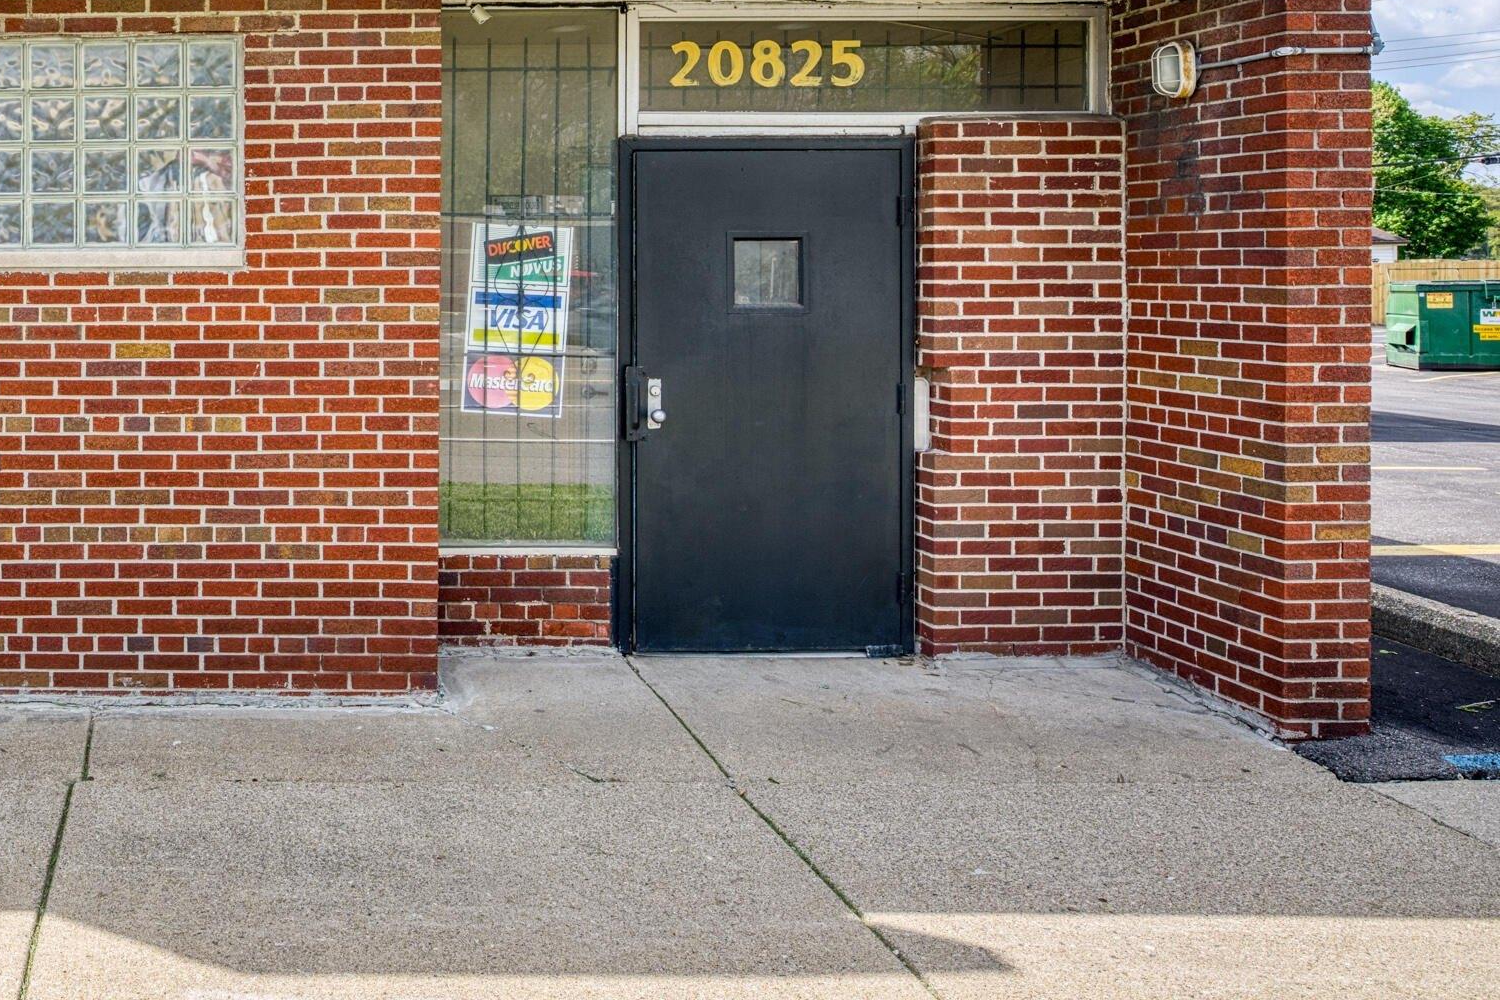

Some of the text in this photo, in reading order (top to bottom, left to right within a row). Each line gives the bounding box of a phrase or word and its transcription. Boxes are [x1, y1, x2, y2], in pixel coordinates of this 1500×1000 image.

[669, 39, 866, 88] 20825
[488, 235, 552, 257] DISCOVER
[490, 308, 544, 330] VISA
